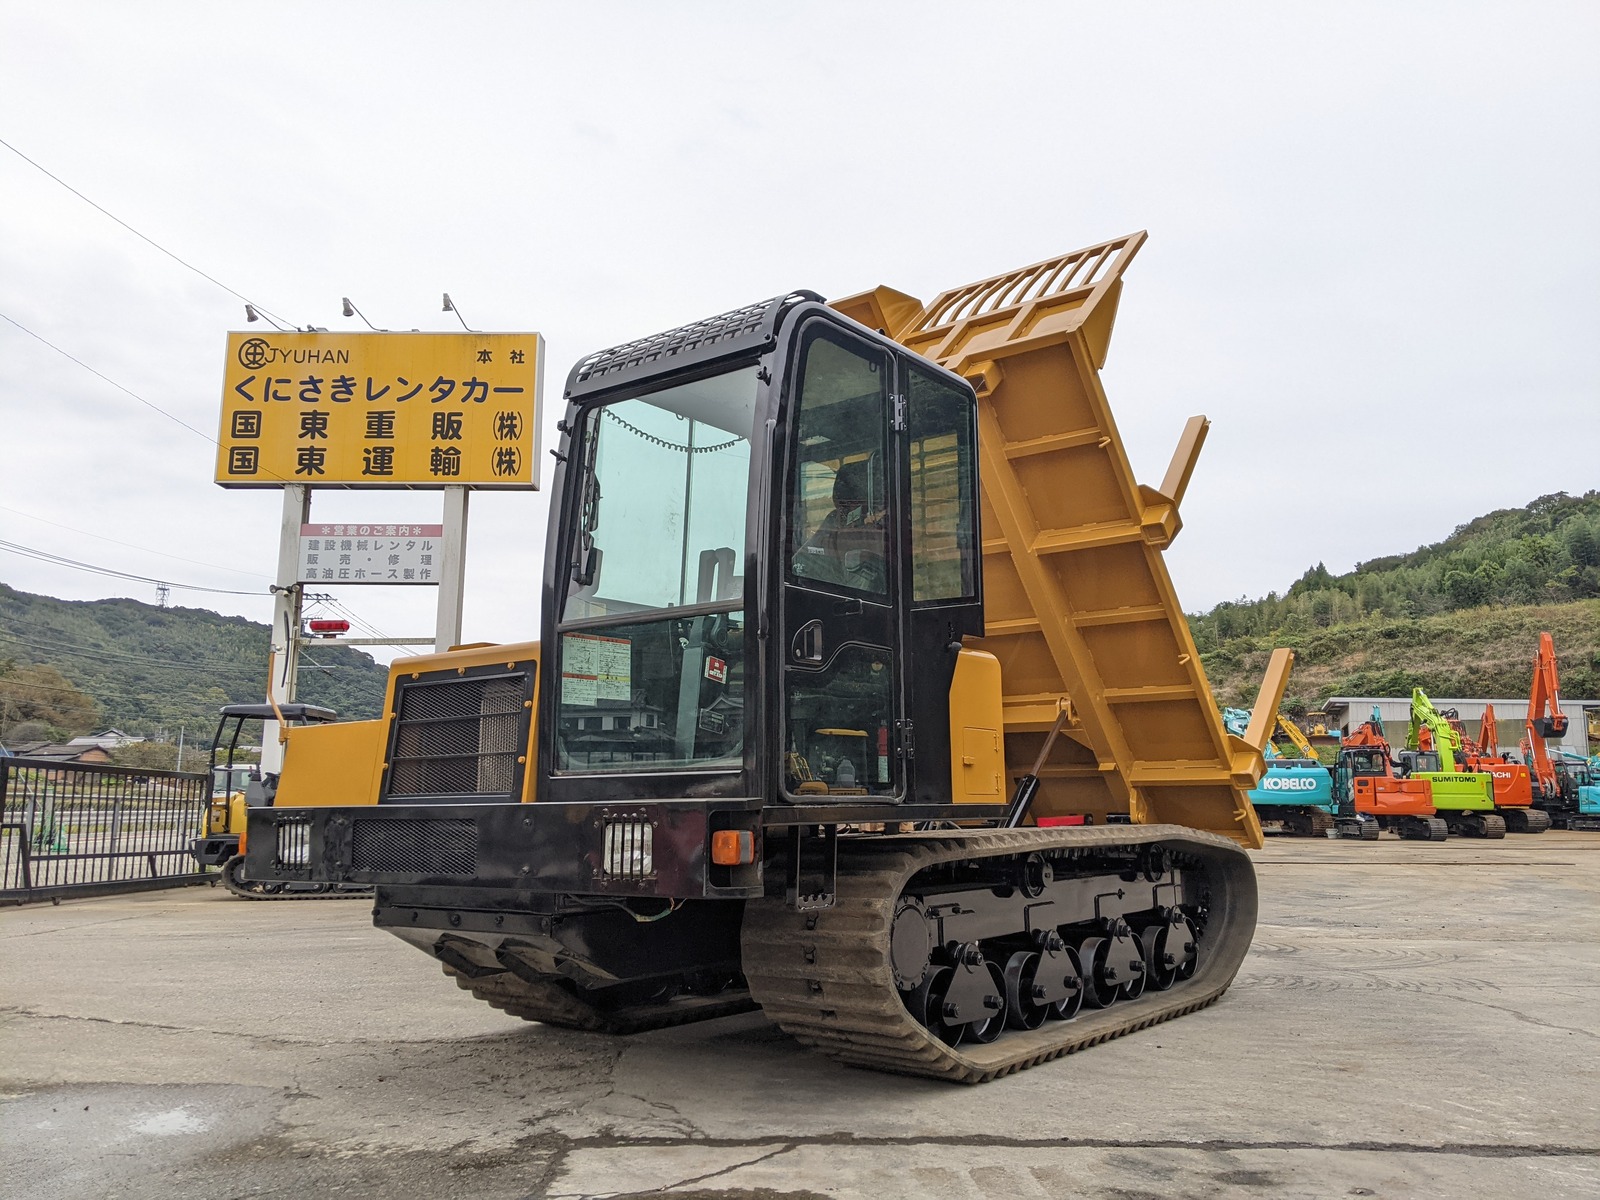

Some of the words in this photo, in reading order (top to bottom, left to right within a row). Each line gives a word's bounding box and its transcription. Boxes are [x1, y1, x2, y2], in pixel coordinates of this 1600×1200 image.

[477, 349, 525, 364] 本社
[235, 375, 524, 403] くにさきレンタカー
[308, 539, 433, 551] 建設機械レンタル
[305, 567, 431, 580] 高油圧ホース製作
[1263, 778, 1317, 790] KOBELCO
